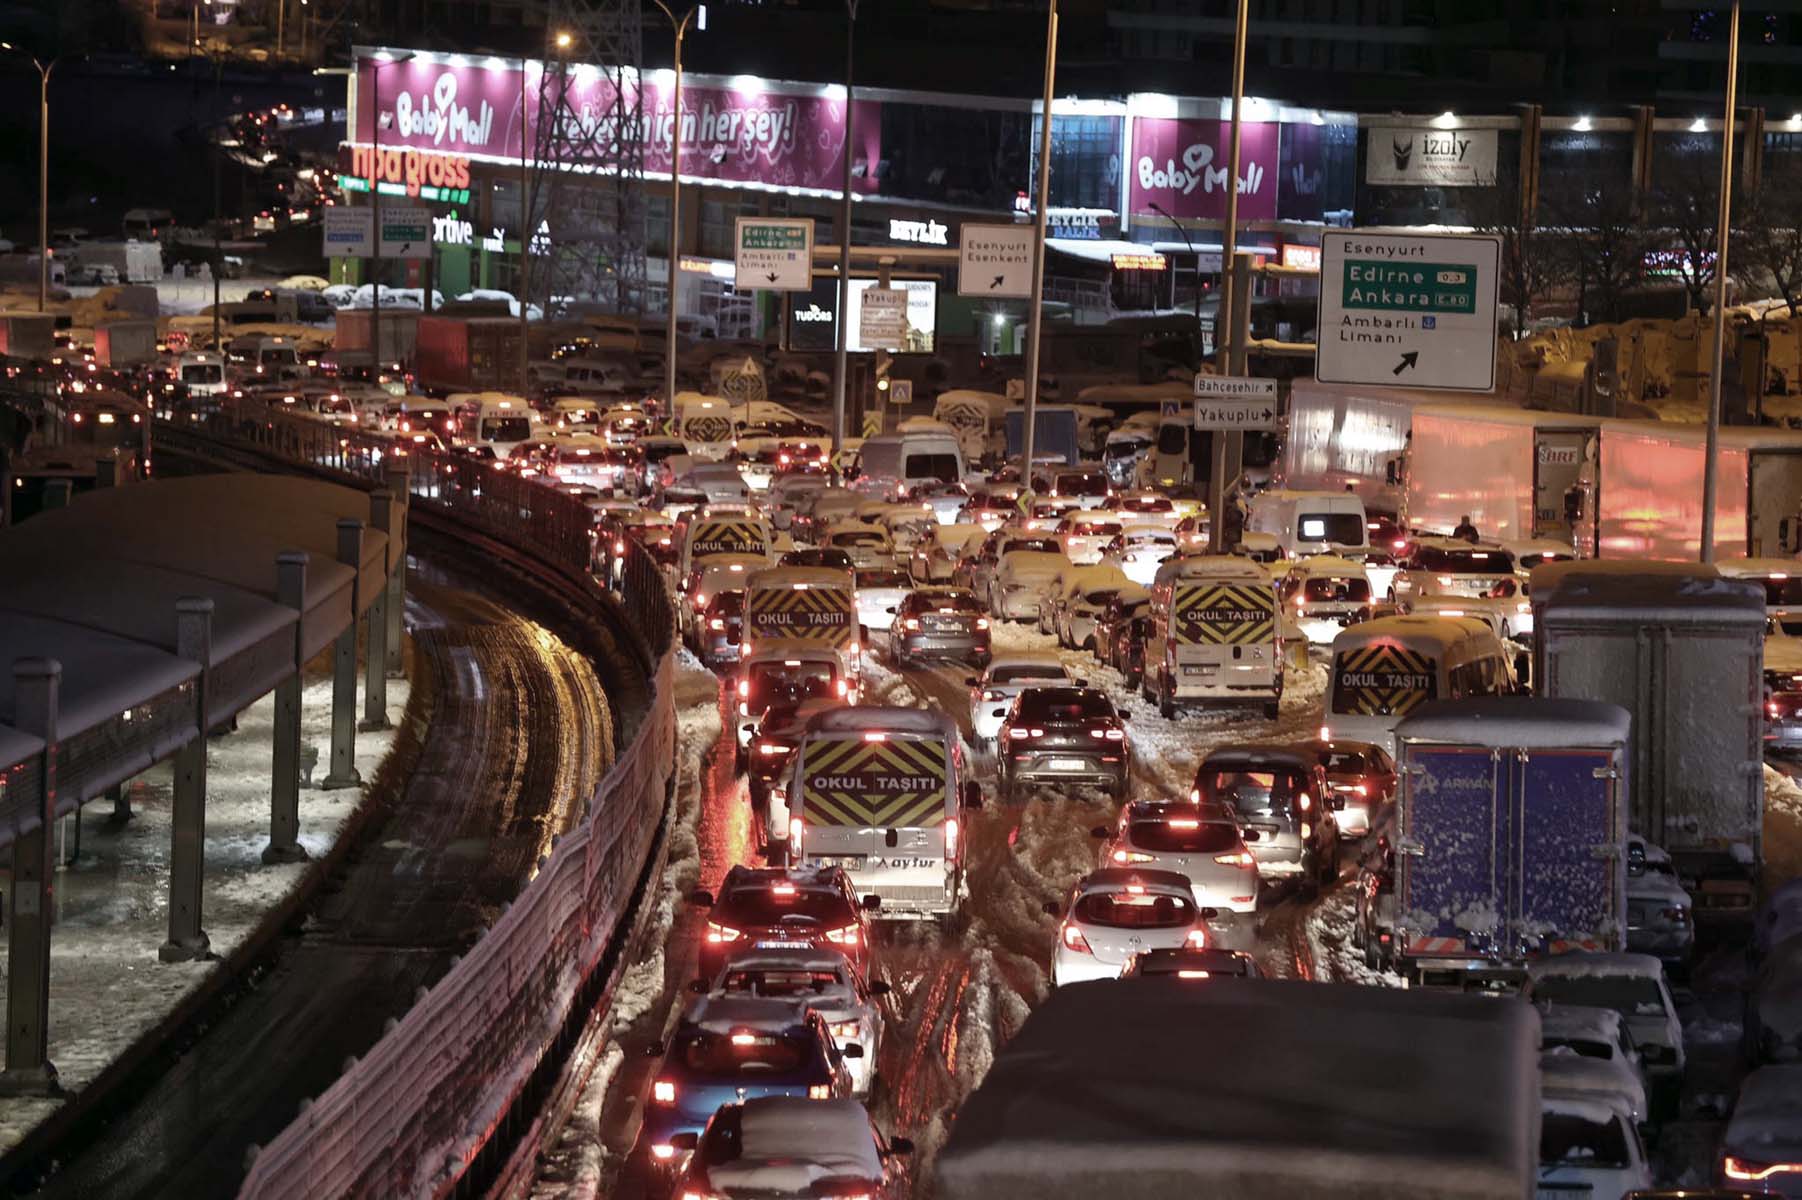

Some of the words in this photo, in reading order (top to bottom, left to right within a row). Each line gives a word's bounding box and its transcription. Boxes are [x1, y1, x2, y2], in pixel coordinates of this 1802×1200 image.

[396, 90, 448, 146] Baby
[449, 100, 494, 146] Mall
[701, 103, 743, 142] her
[743, 103, 794, 153] şey!
[1137, 155, 1201, 196] Baby
[1203, 164, 1264, 195] Mall
[968, 240, 1027, 252] Esenyurt
[1343, 241, 1425, 258] Esenyurt
[968, 251, 1028, 263] Esenkent
[1350, 266, 1424, 285] Edirne
[1349, 287, 1429, 306] Ankara
[1341, 314, 1415, 329] Ambarlı
[1339, 329, 1402, 344] Limanı
[1199, 407, 1260, 425] Yakuplu
[758, 613, 794, 625] OKUL
[1187, 610, 1223, 621] OKUL
[1342, 673, 1379, 687] OKUL
[814, 776, 868, 789] OKUL
[876, 776, 937, 792] TAŞITI
